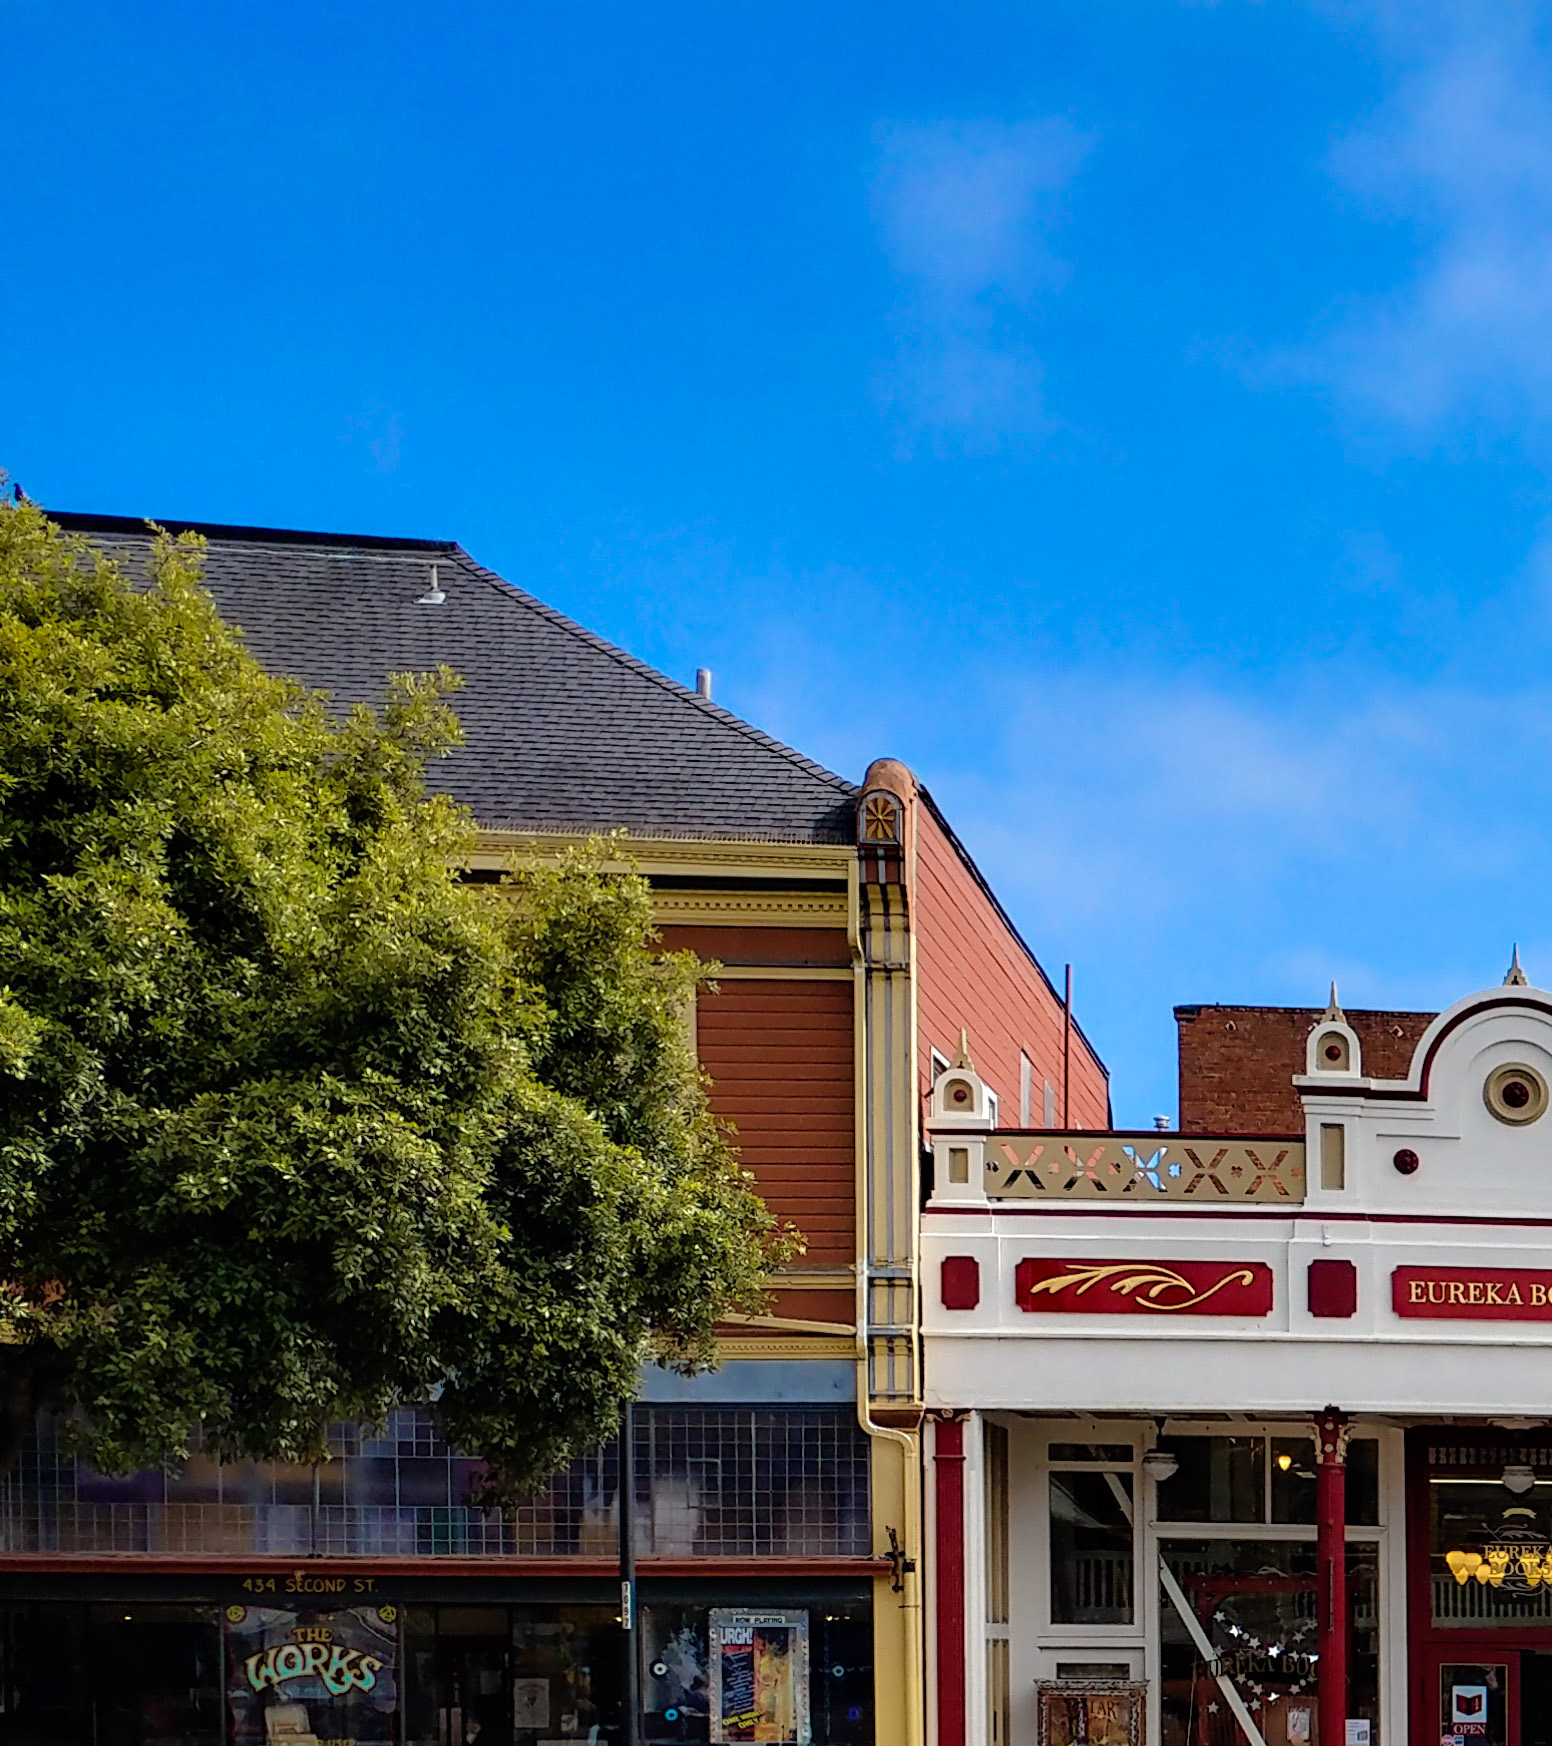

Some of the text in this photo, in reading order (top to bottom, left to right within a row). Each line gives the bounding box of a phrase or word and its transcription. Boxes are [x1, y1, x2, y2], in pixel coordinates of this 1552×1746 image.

[1409, 1281, 1524, 1305] EUREKA
[1489, 1561, 1551, 1576] BOOKS
[242, 1578, 379, 1593] 434 SECOND ST.
[292, 1627, 334, 1643] THE
[720, 1627, 753, 1645] URGH!
[245, 1642, 385, 1696] WORKS
[1453, 1724, 1486, 1734] OPEN
